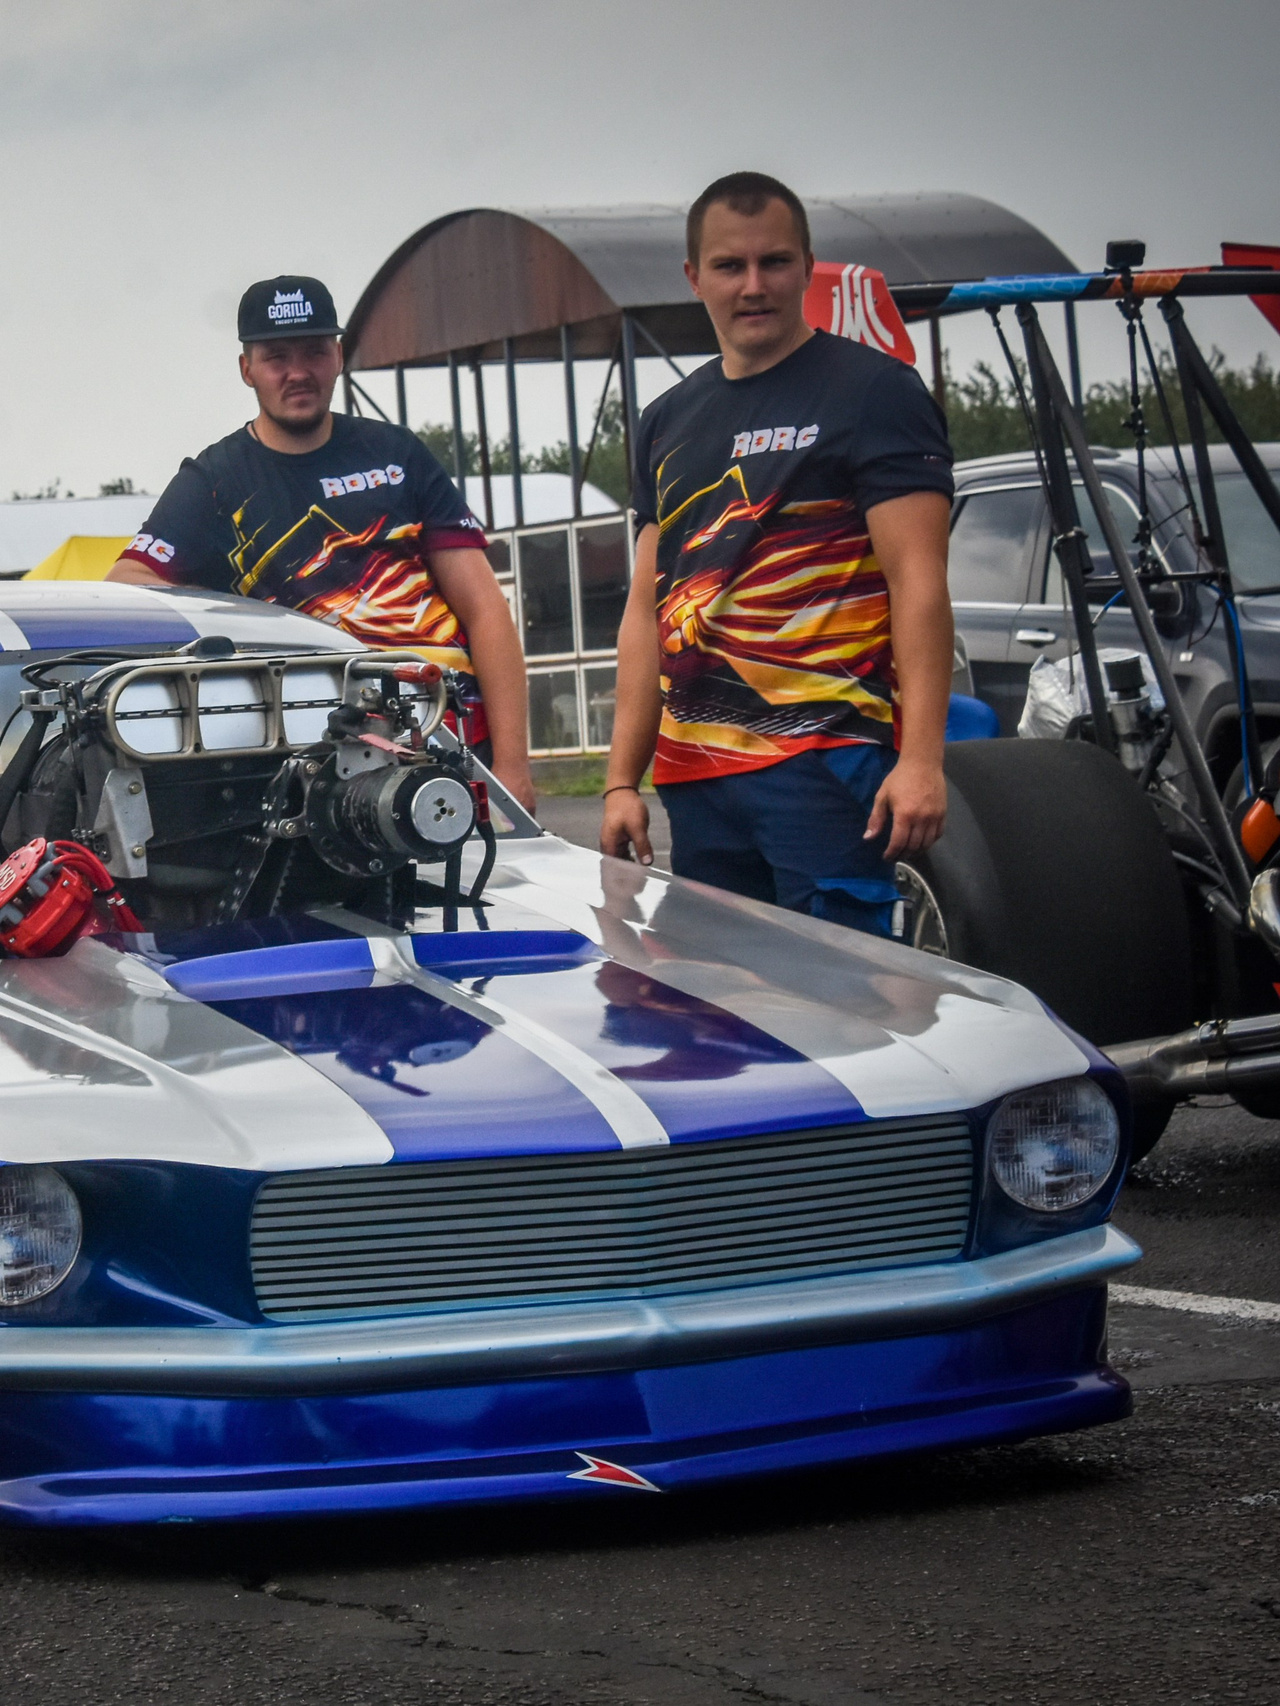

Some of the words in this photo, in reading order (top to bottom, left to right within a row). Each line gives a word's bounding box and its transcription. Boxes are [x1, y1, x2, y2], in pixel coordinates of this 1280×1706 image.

[267, 301, 313, 319] GORILLA
[730, 423, 819, 459] RDRC
[319, 464, 405, 499] RDRC
